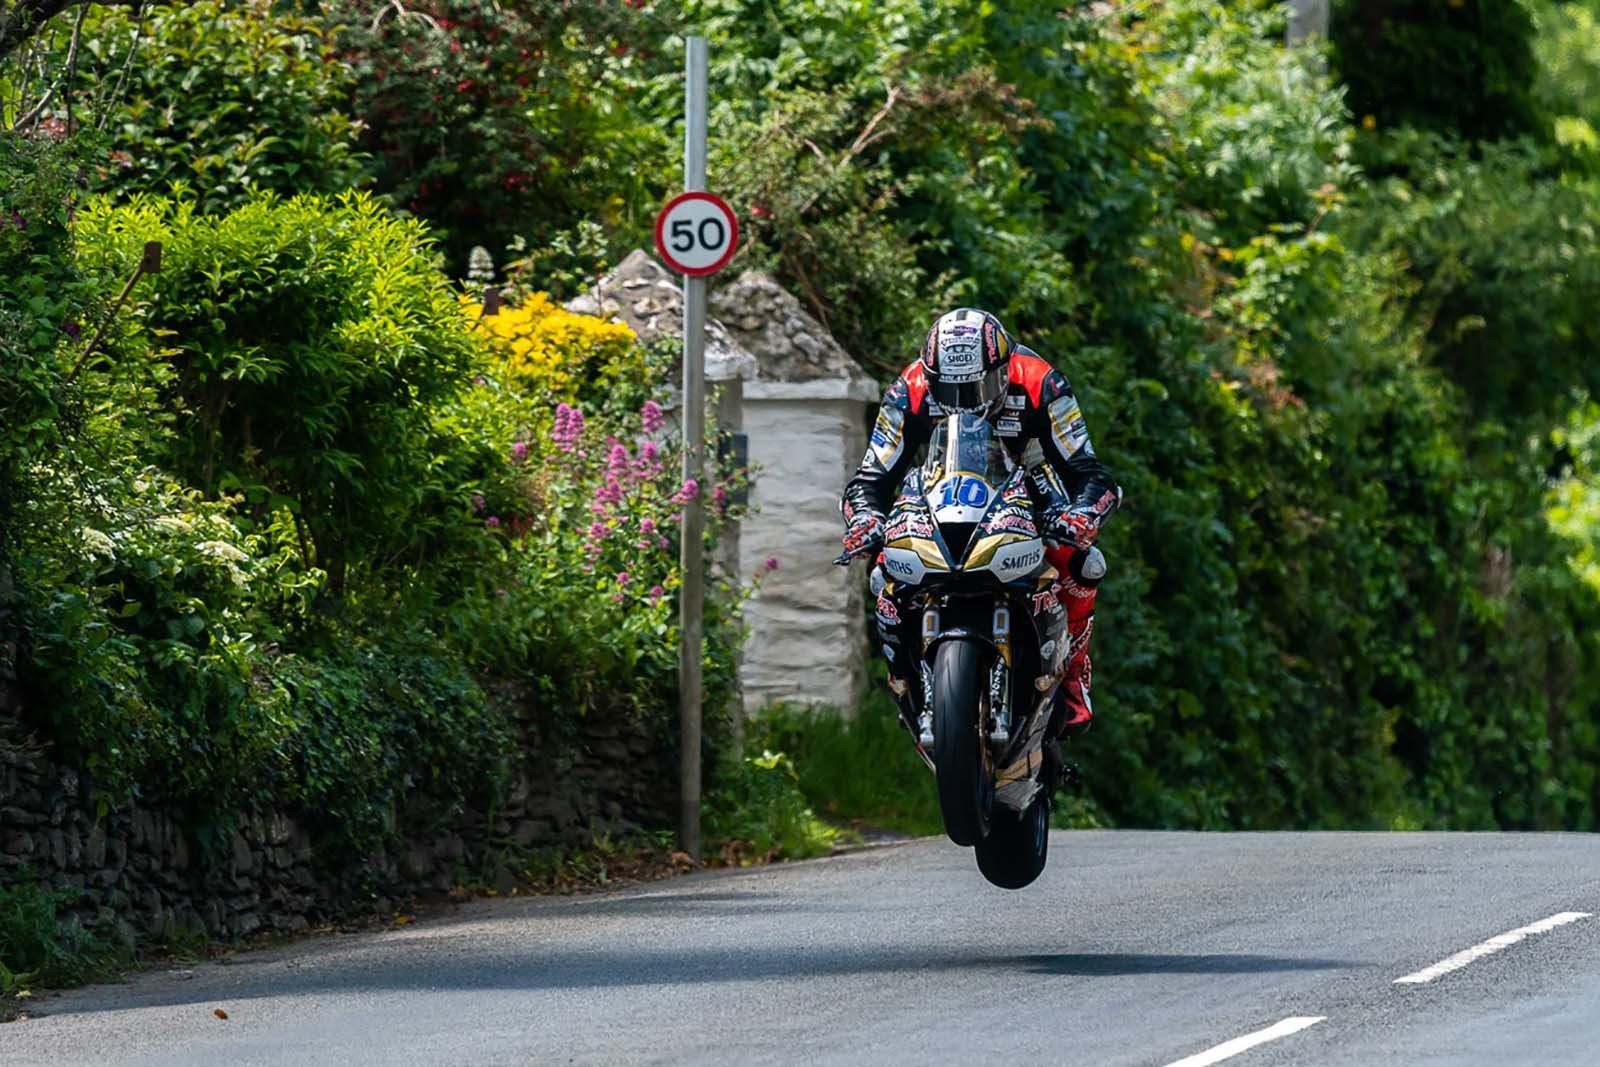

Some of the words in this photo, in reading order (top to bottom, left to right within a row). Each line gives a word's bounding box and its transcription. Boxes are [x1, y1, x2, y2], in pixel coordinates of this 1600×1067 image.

[671, 217, 725, 253] 50
[937, 475, 989, 511] 10
[1000, 548, 1041, 571] SMITHS
